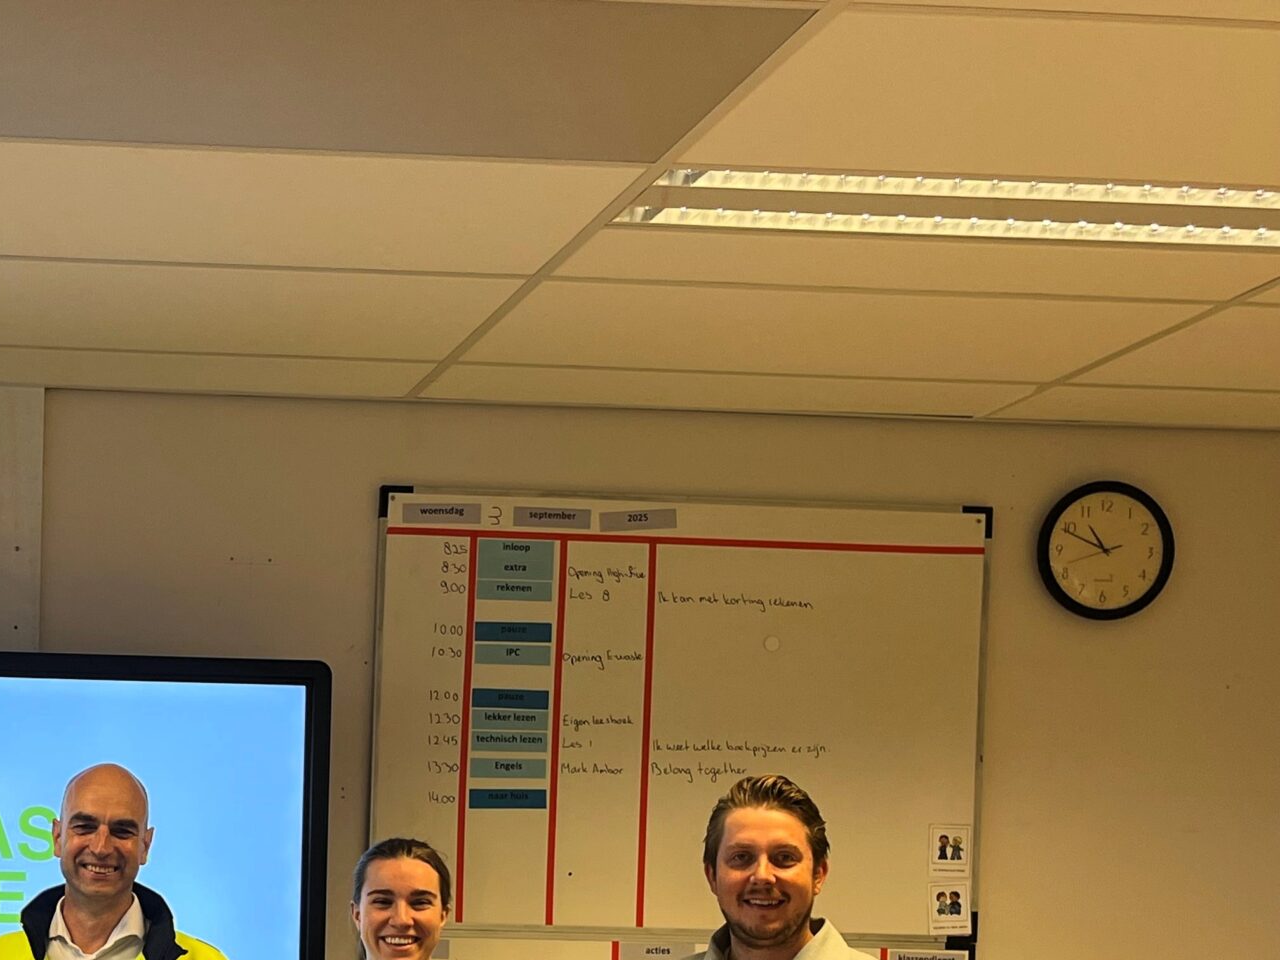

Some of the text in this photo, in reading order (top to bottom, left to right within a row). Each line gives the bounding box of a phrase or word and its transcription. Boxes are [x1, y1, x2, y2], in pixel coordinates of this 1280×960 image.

[420, 506, 464, 517] woensdag
[1101, 500, 1114, 512] 12
[488, 506, 502, 525] 3
[529, 511, 576, 522] september
[1081, 506, 1091, 518] 11
[1128, 508, 1132, 519] 1
[627, 514, 649, 522] 2025
[1141, 523, 1149, 535] 2
[502, 543, 531, 552] inloop
[1056, 544, 1064, 555] 9
[1148, 547, 1154, 559] 3
[504, 563, 527, 572] extra
[1062, 568, 1069, 579] 8
[1138, 569, 1146, 581] 4
[496, 583, 532, 592] rekenen
[1078, 584, 1085, 595] 7
[1123, 586, 1129, 597] 5
[570, 588, 610, 601] Les 8
[1099, 591, 1106, 603] 6
[699, 593, 718, 604] met
[723, 594, 766, 612] korting
[506, 648, 521, 657] IPC
[563, 652, 604, 670] Opening
[485, 713, 536, 722] lekker lezen
[477, 735, 543, 744] technisch lezen
[562, 738, 582, 748] Les
[653, 740, 662, 752] Ik
[666, 739, 688, 751] weet
[693, 740, 721, 751] welke
[495, 762, 522, 772] Engels
[560, 763, 587, 774] Mark
[651, 762, 747, 783] Belong together
[645, 946, 670, 955] acties
